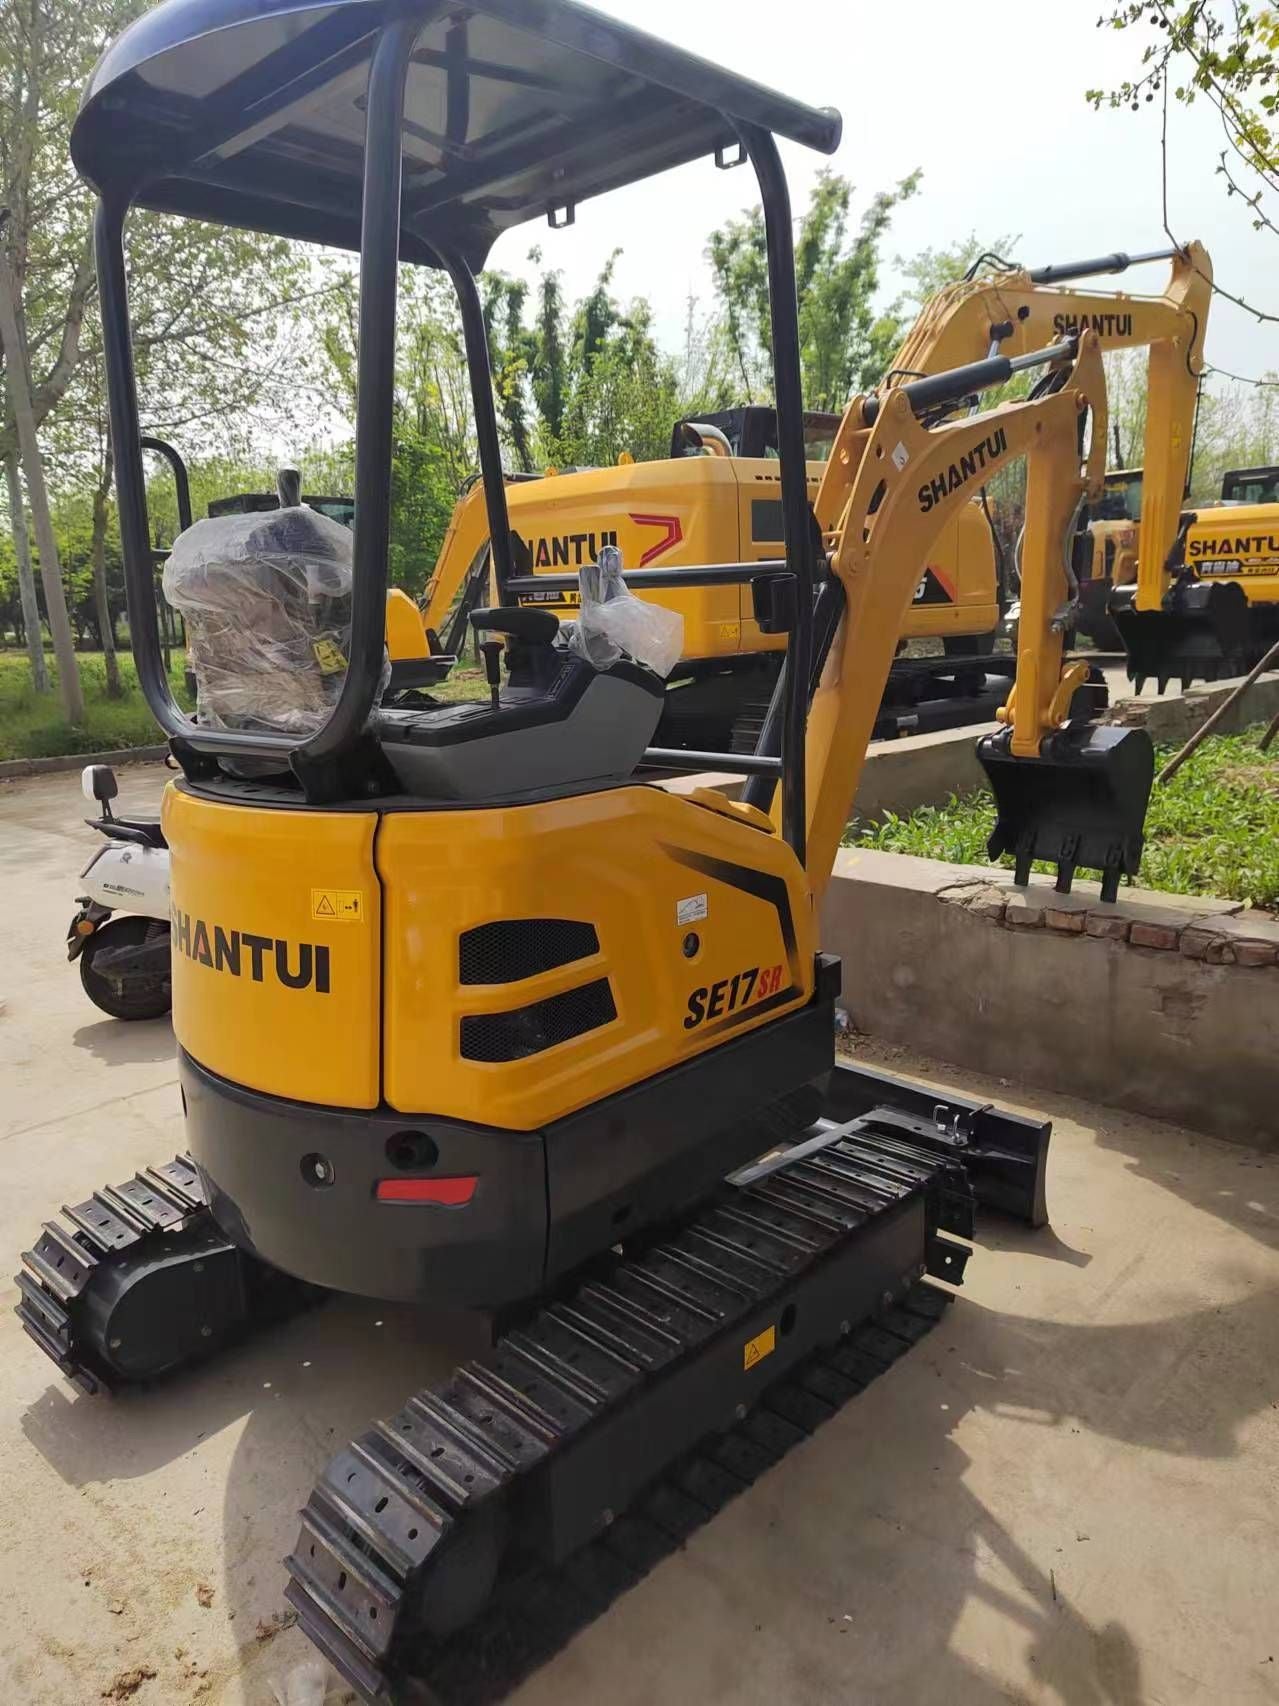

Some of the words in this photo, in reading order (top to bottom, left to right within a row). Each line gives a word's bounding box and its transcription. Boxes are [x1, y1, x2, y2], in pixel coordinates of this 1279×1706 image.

[1053, 312, 1132, 337] SHANTUI
[918, 427, 1007, 513] SHANTUI
[1189, 536, 1279, 557] SHANTU
[171, 902, 331, 994] SHANTUI
[683, 965, 783, 1030] SE17SR
